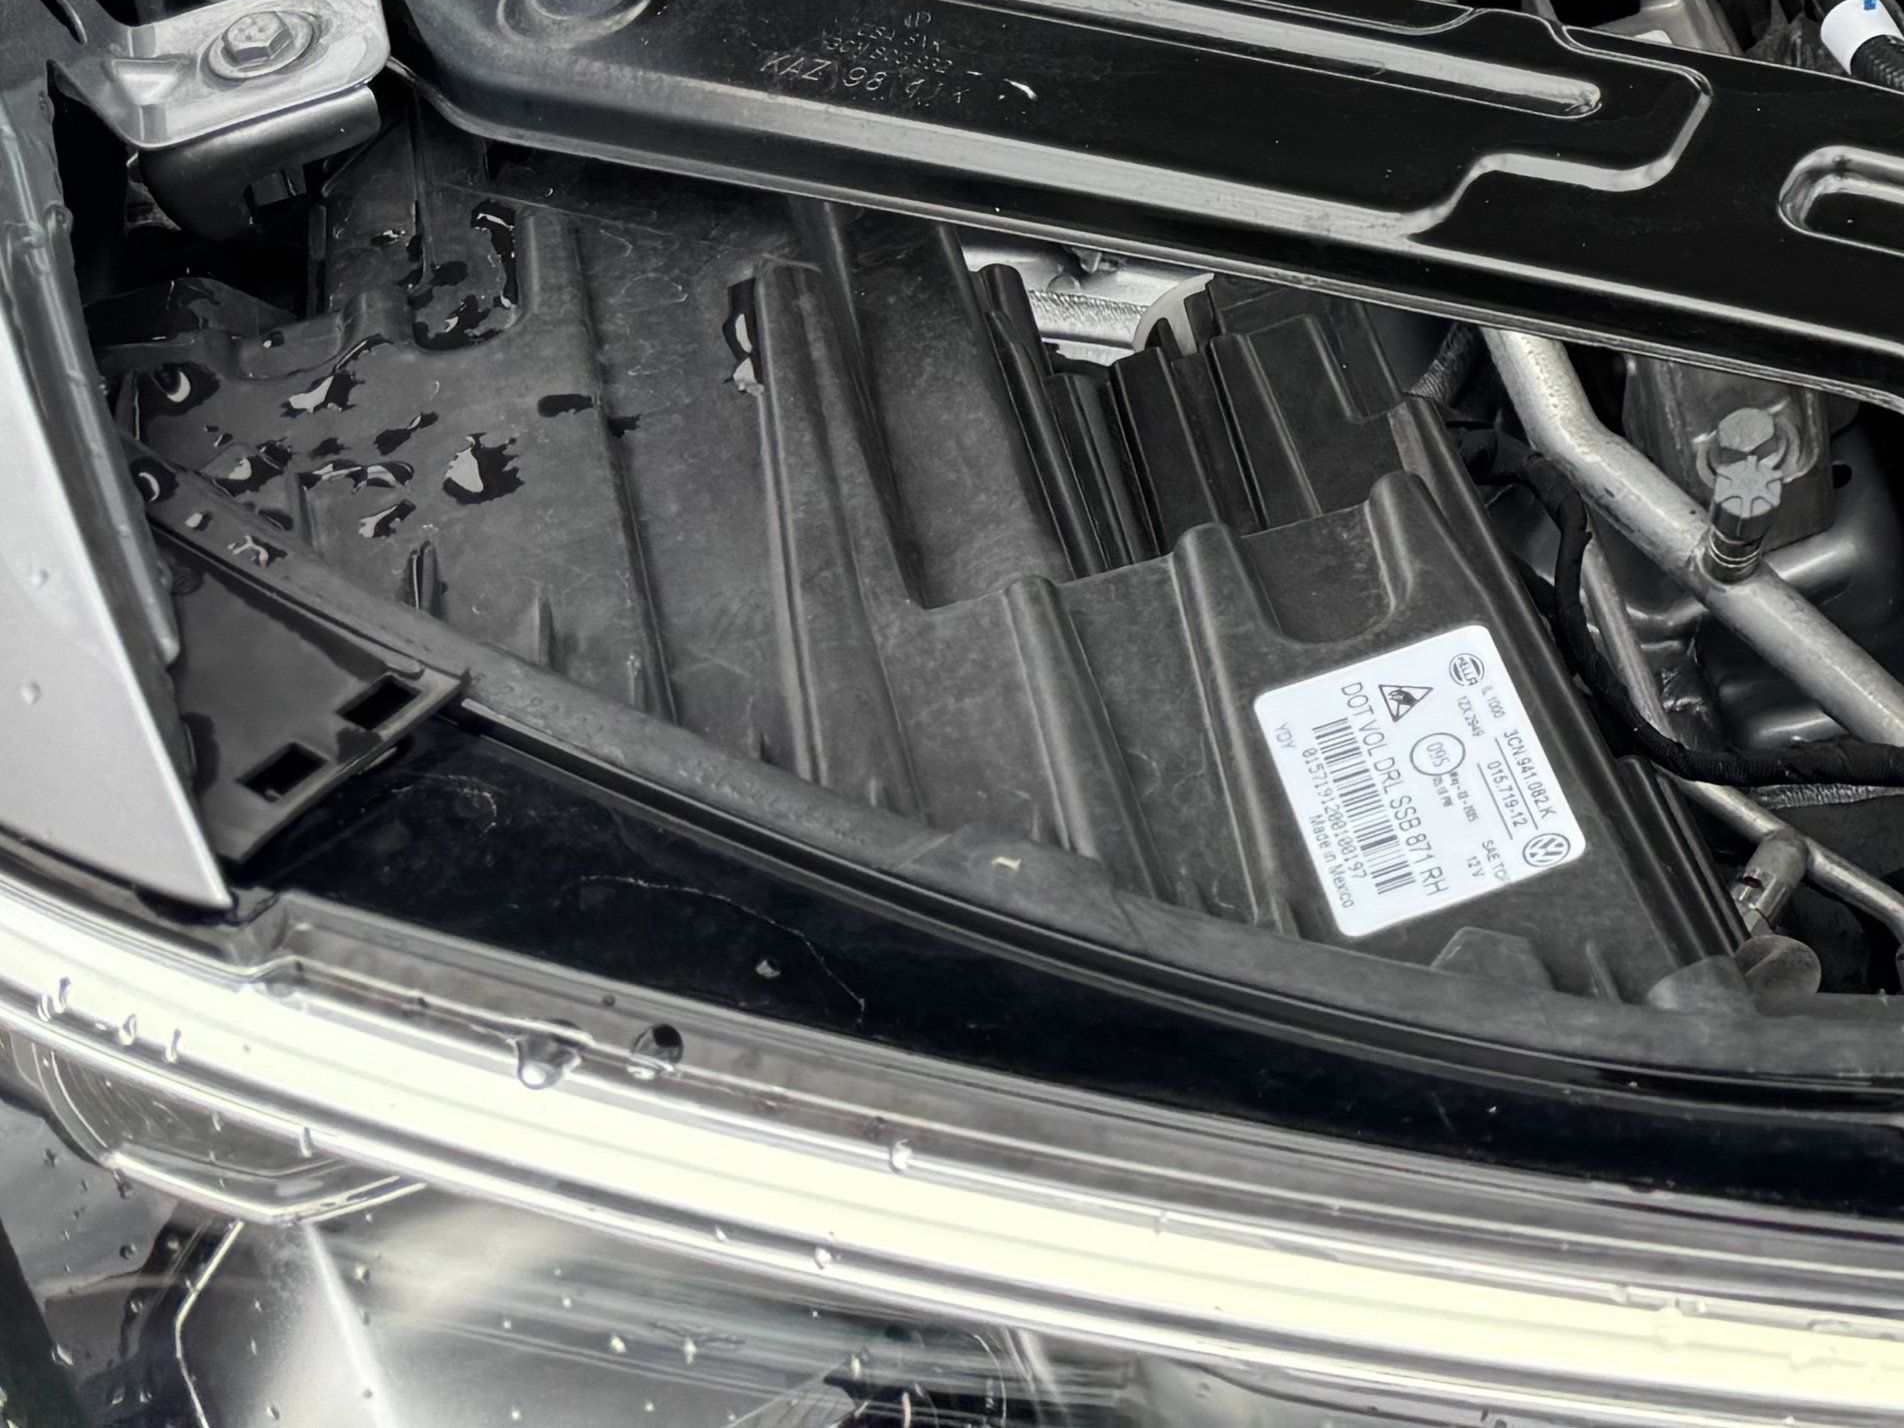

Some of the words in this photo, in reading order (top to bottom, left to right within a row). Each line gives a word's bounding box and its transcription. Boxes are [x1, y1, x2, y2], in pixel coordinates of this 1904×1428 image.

[1457, 656, 1477, 685] HELLA
[1340, 681, 1375, 717] DOT
[1358, 719, 1388, 757] VOL
[1373, 757, 1404, 794] DRL
[1309, 813, 1332, 849] Made
[1389, 795, 1422, 831] SSB
[1323, 851, 1337, 863] in
[1405, 833, 1435, 864] 871
[1329, 863, 1355, 909] Mexico
[1419, 866, 1448, 896] RH
